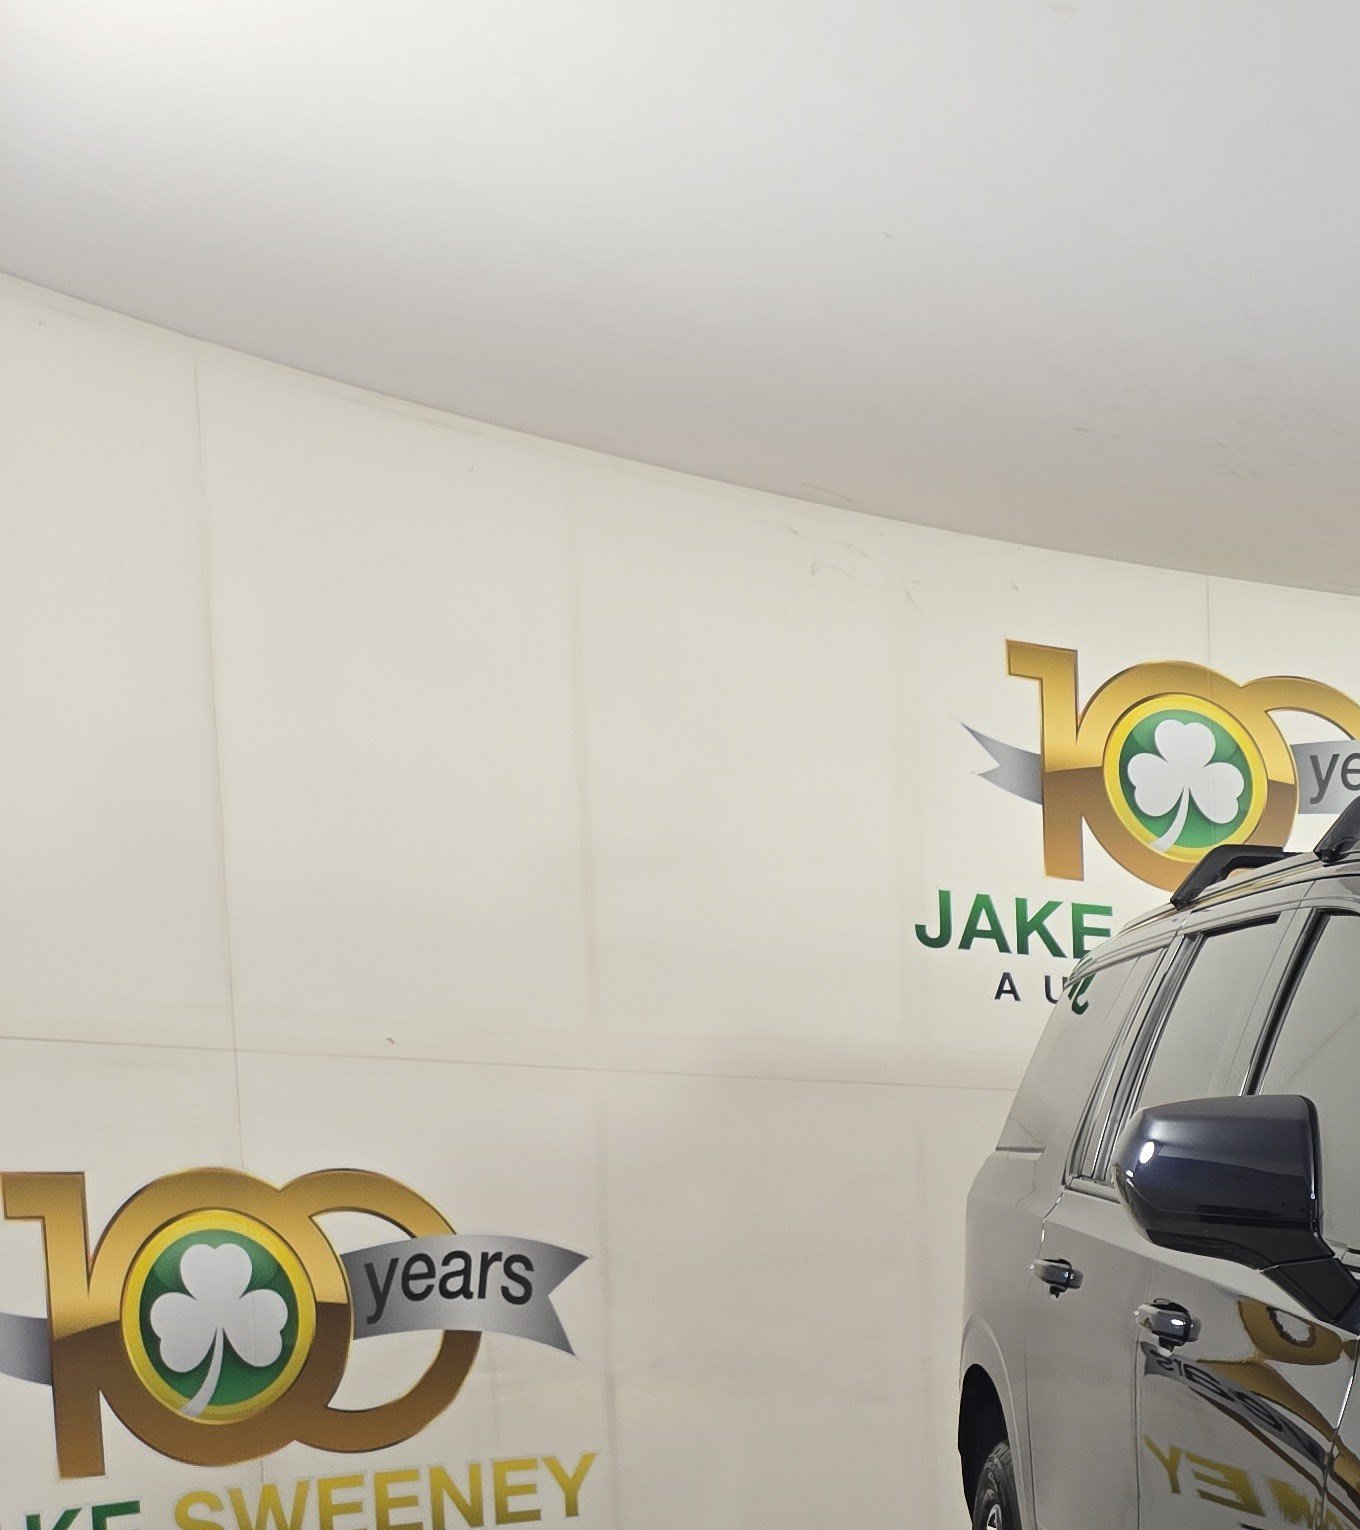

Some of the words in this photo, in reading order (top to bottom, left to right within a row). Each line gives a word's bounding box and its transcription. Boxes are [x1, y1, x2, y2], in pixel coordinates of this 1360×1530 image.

[914, 888, 1113, 958] JAKE
[2, 1166, 484, 1480] 100
[364, 1249, 534, 1324] years
